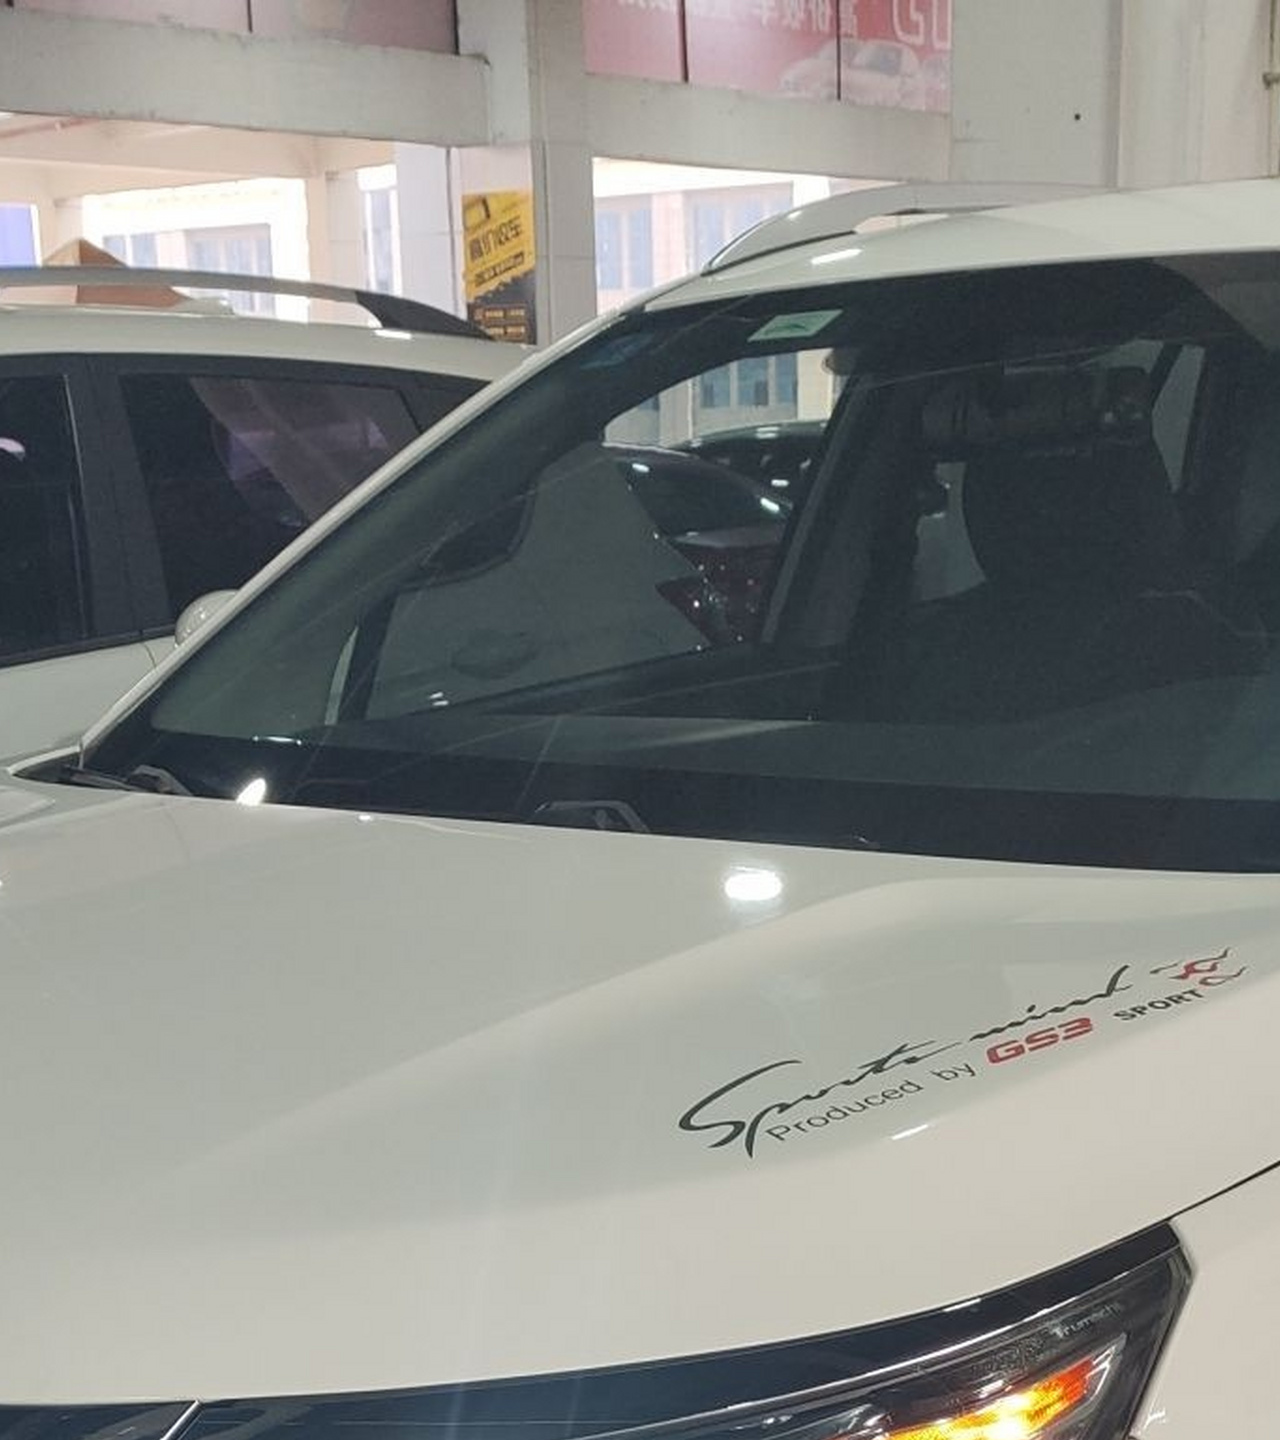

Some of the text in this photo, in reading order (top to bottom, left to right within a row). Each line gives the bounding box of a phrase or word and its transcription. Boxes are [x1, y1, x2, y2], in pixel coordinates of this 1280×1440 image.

[766, 988, 1205, 1142] Produced by GS3 SPORT
